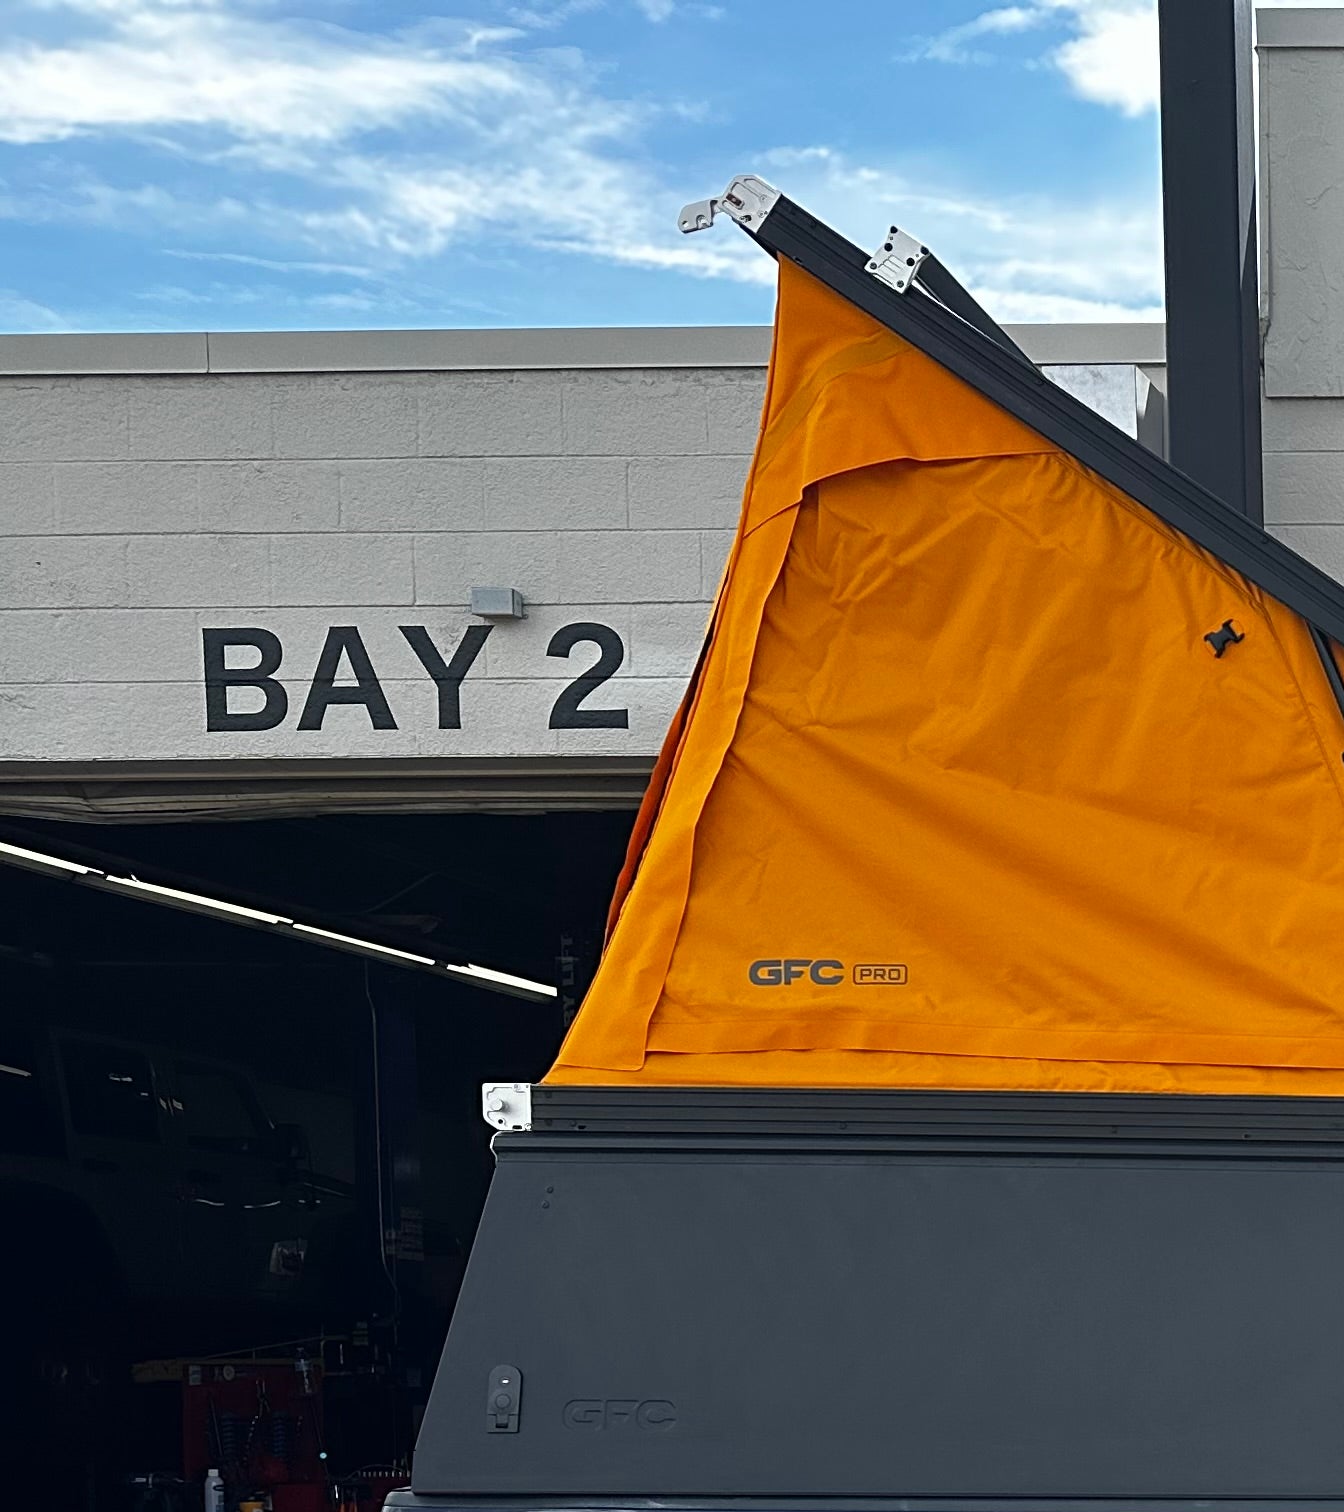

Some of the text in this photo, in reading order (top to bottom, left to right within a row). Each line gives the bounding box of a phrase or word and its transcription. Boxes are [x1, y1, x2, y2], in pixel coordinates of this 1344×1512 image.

[202, 621, 629, 732] BAY 2
[748, 958, 902, 985] GFC PRO
[562, 1399, 676, 1431] GFC
